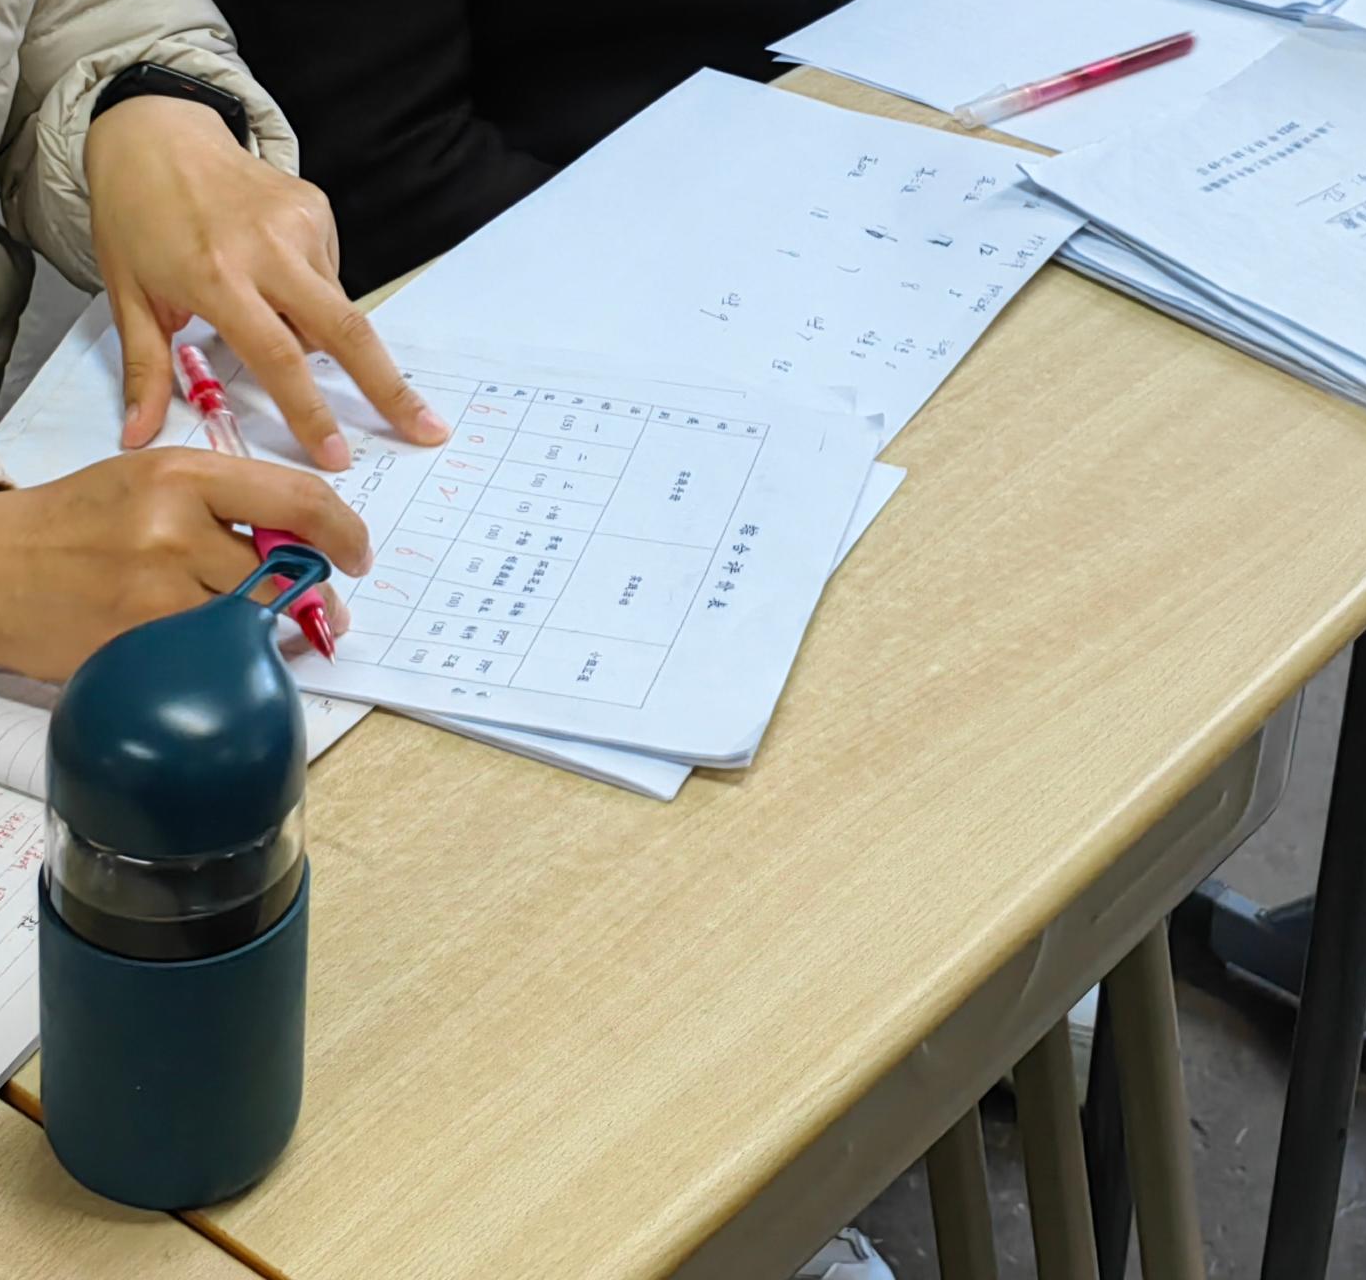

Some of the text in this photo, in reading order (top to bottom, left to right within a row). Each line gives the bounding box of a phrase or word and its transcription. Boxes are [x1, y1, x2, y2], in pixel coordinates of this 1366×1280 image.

[707, 523, 760, 609] 综合评价表
